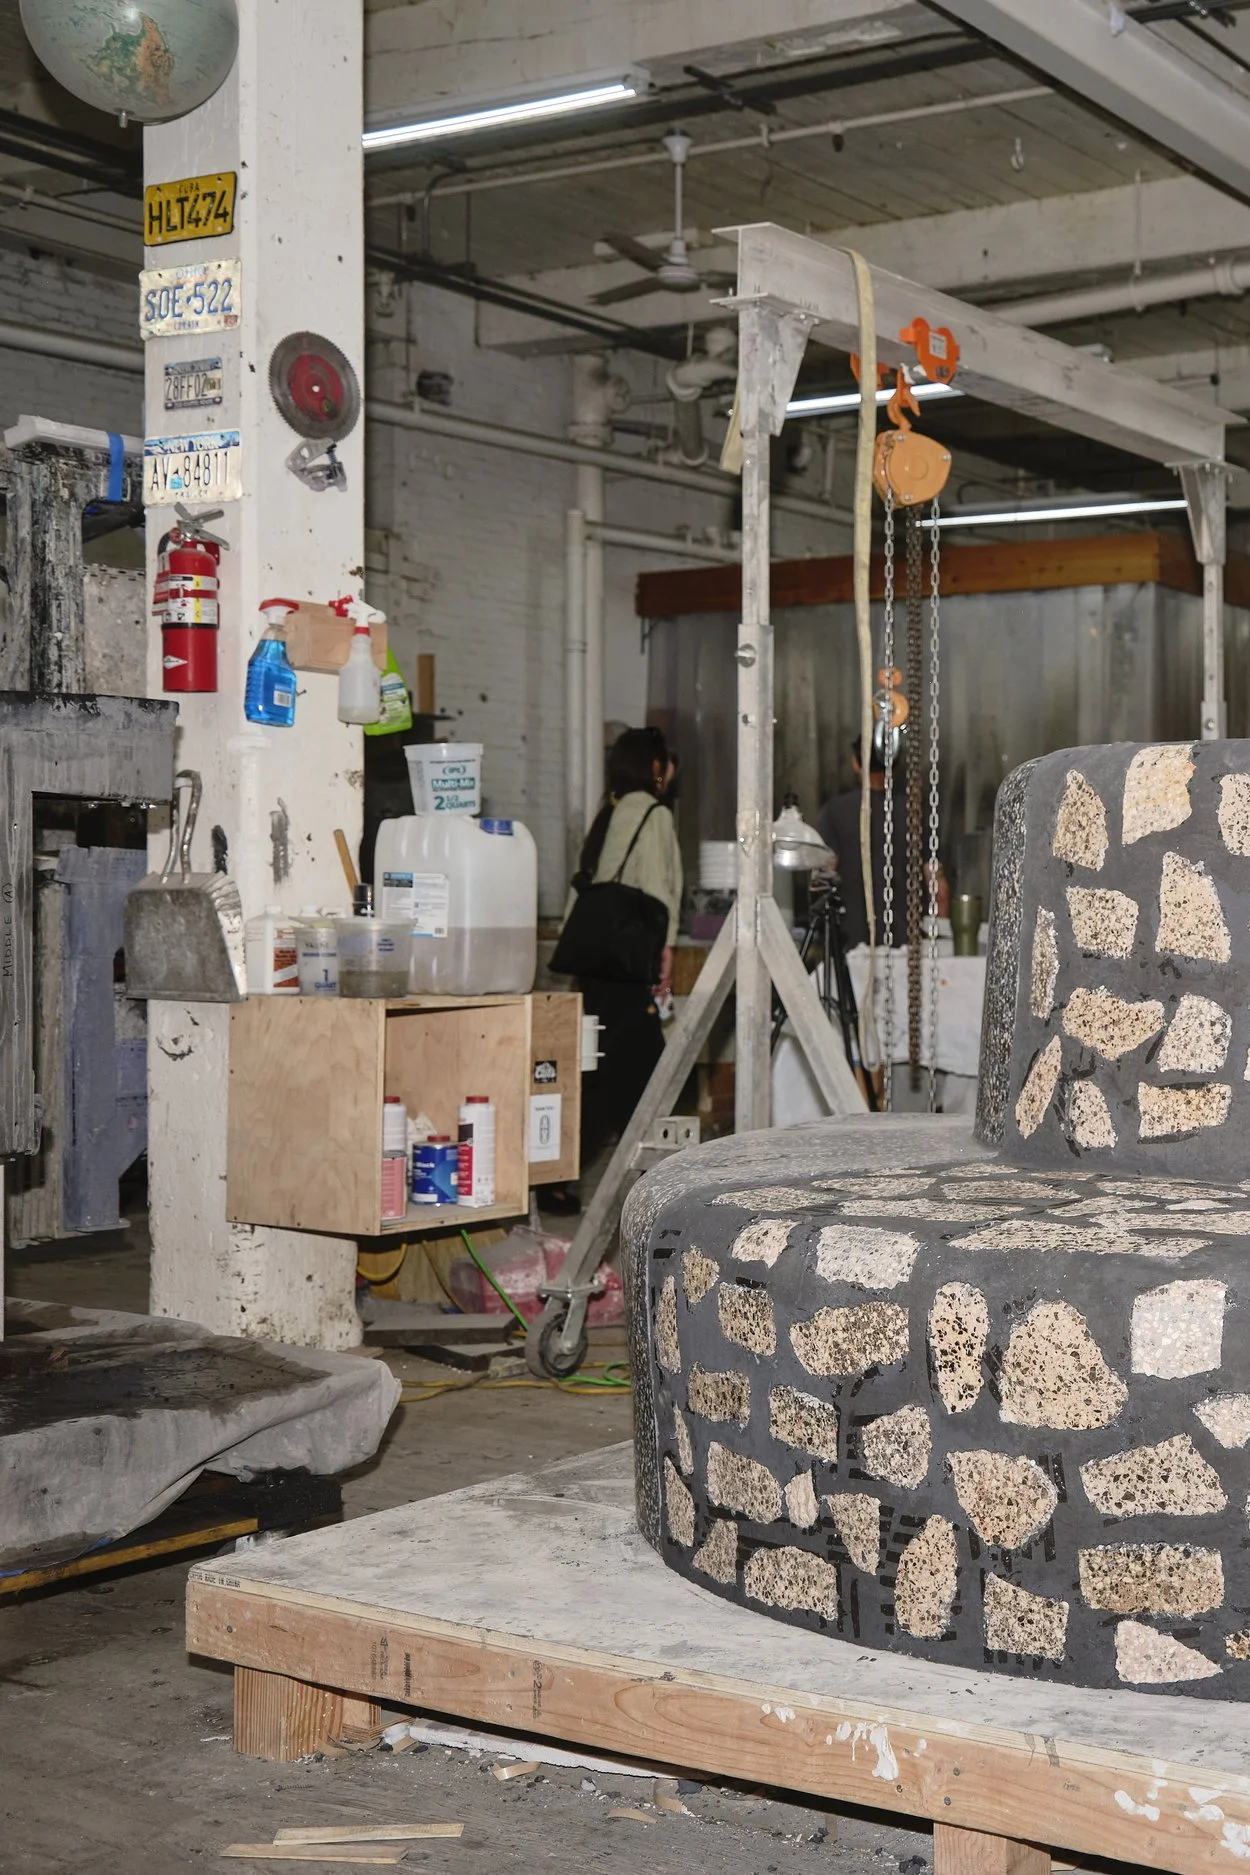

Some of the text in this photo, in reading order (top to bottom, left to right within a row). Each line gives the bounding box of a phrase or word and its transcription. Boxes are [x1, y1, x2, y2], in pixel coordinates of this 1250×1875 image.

[149, 190, 229, 235] HLT474
[434, 795, 446, 811] 2
[3, 916, 13, 977] MIDDLE
